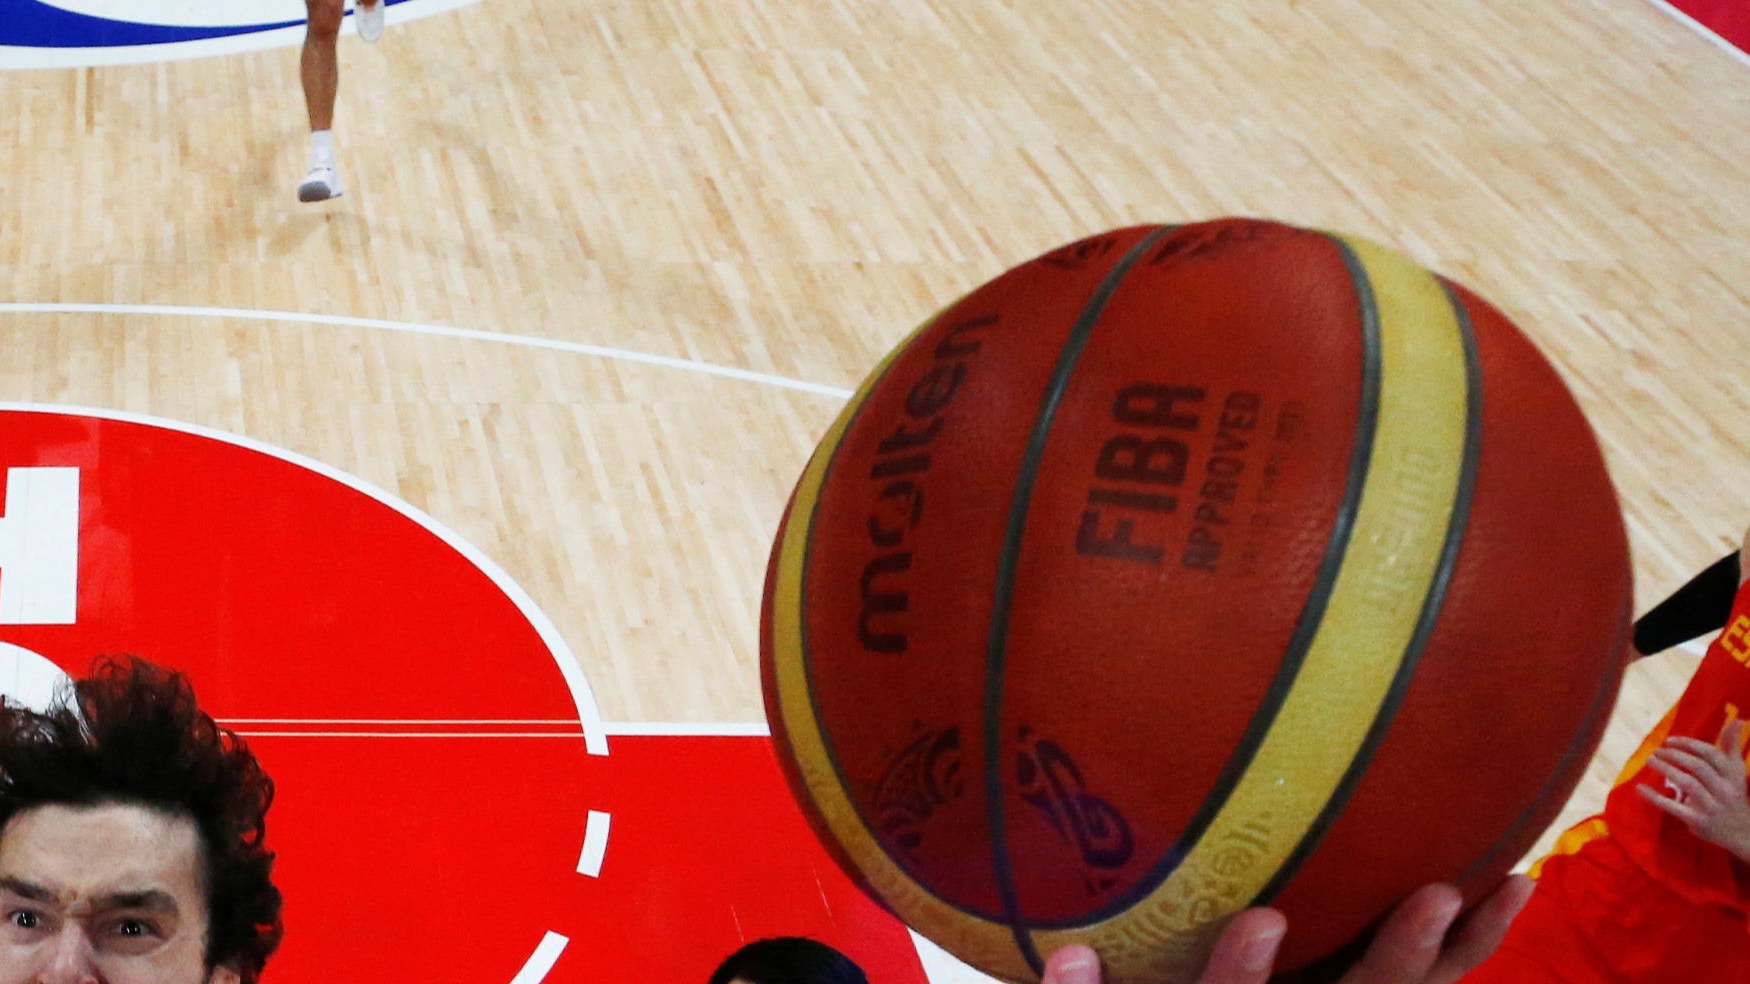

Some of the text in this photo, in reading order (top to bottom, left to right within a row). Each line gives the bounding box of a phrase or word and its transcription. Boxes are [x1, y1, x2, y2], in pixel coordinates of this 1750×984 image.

[858, 313, 999, 654] molten
[1075, 380, 1208, 566] FIBA
[1181, 391, 1263, 573] APPROVED
